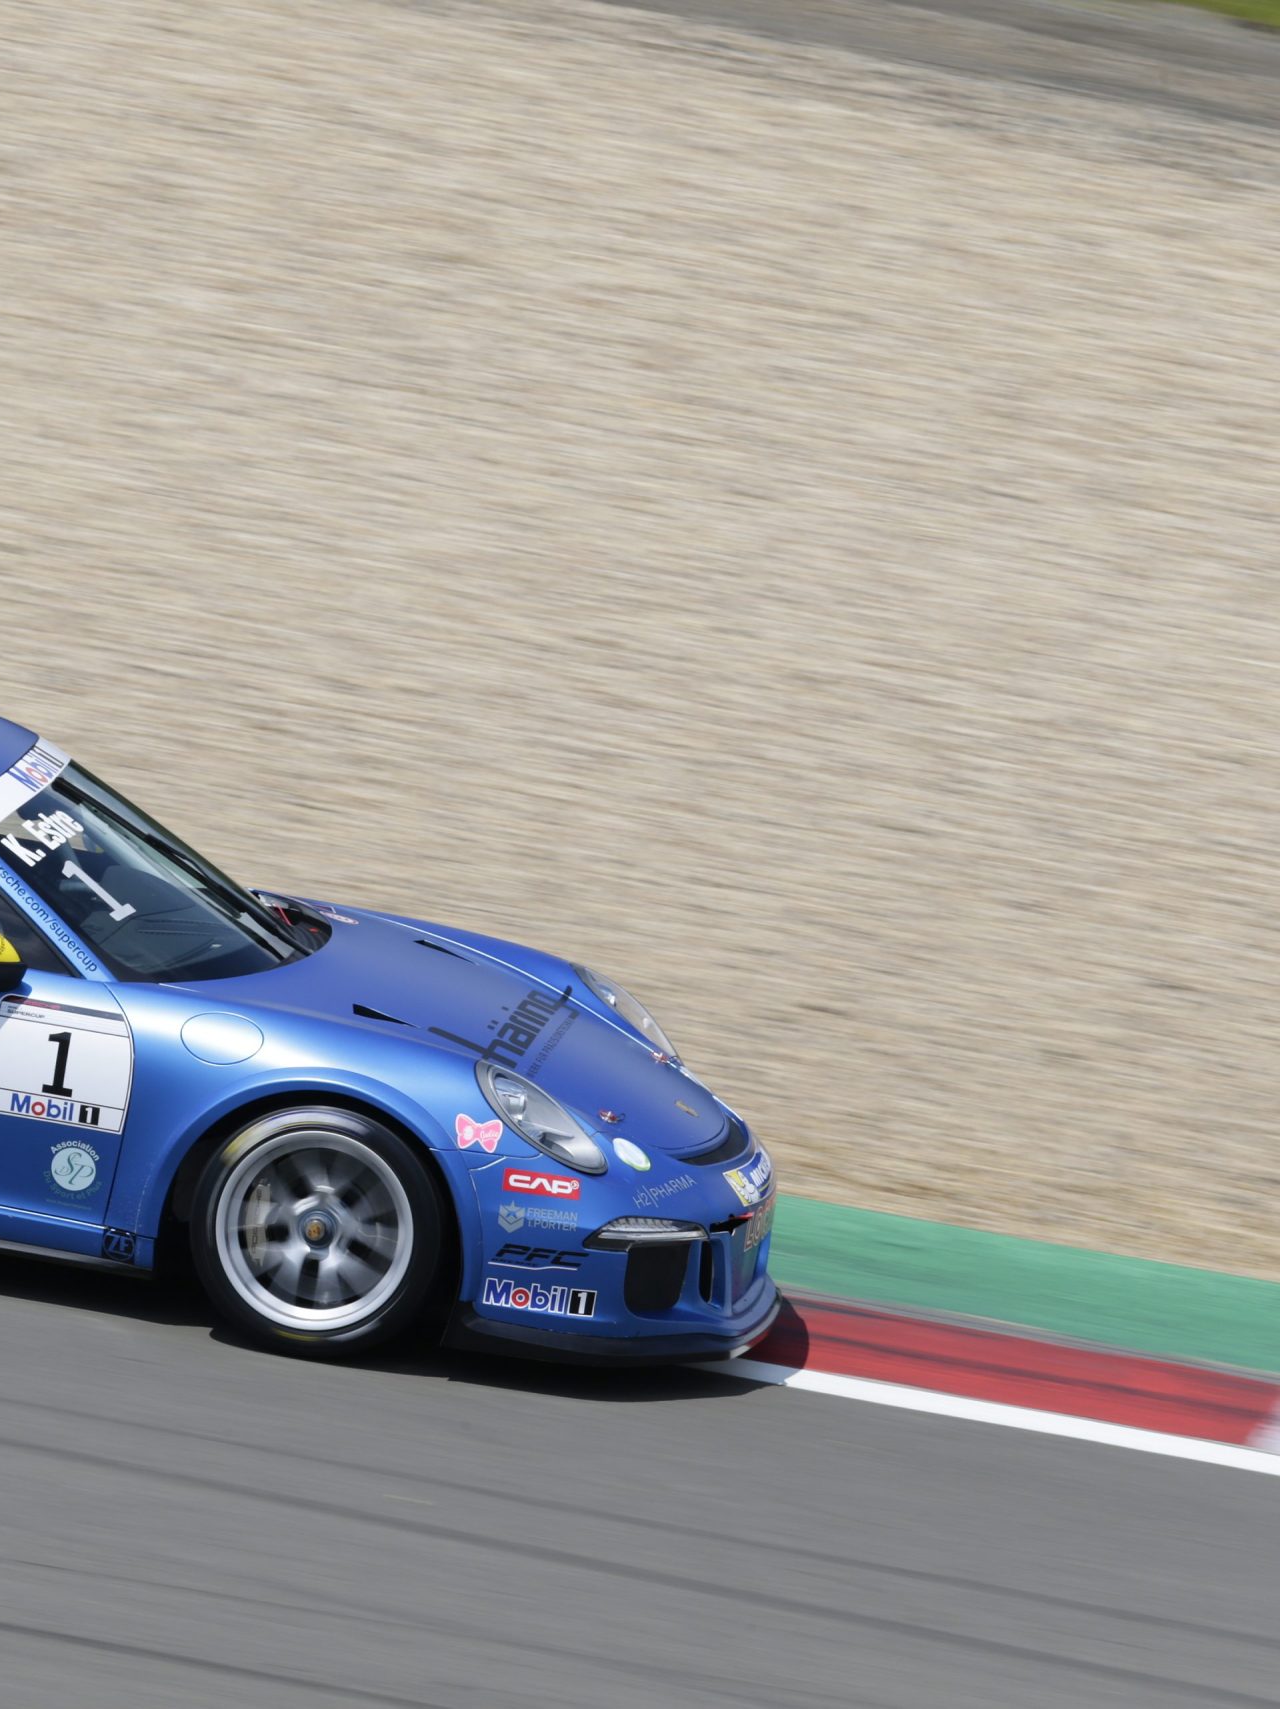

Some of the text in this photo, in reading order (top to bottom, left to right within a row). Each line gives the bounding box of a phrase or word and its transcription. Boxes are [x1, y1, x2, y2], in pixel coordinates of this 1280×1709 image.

[0, 810, 84, 867] K. Estre
[61, 860, 136, 921] 1
[428, 985, 580, 1070] häring
[41, 1031, 73, 1099] 1
[9, 1092, 96, 1125] Mobil 1
[50, 1140, 100, 1162] Association
[508, 1174, 574, 1194] CAP
[527, 1207, 578, 1221] FREEMAN
[495, 1243, 590, 1268] PFC
[483, 1277, 568, 1314] Mobil
